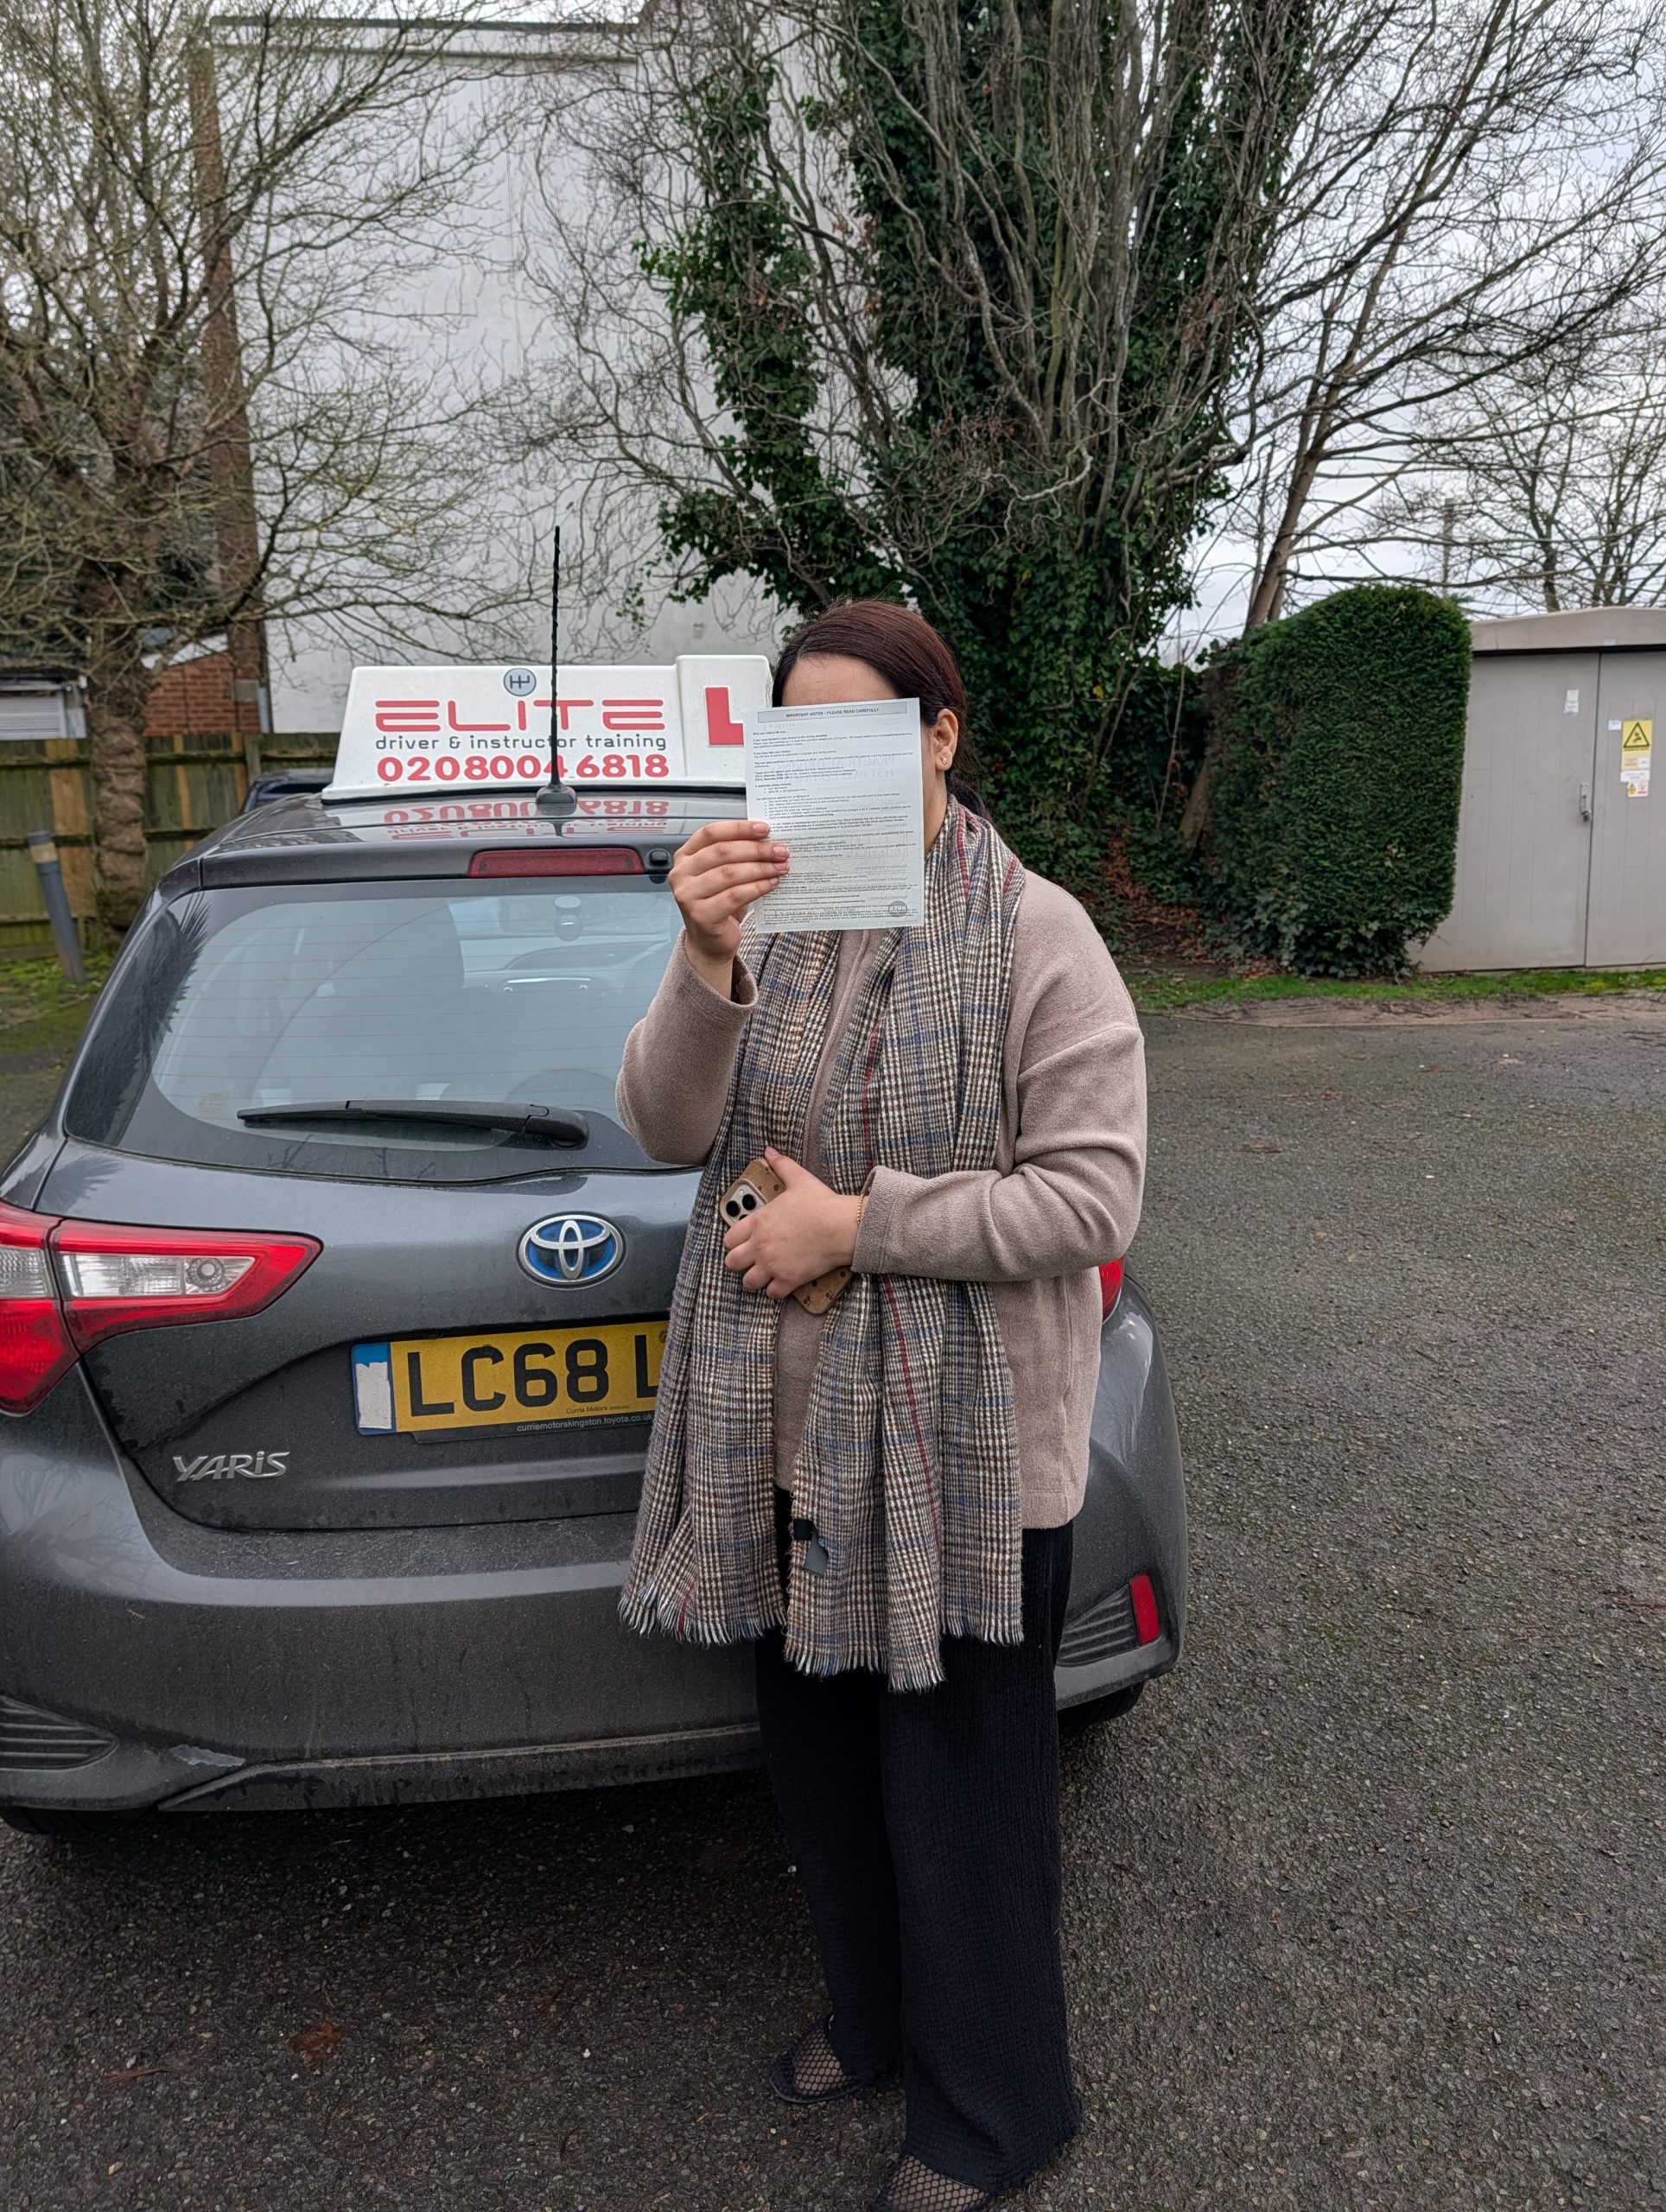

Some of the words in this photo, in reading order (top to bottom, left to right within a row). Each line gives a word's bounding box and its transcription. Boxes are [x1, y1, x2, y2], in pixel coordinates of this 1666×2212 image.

[375, 699, 664, 732] ELITE
[704, 686, 745, 746] L
[375, 735, 439, 750] driver
[448, 735, 461, 750] &
[586, 734, 667, 752] training
[407, 1338, 610, 1417] LC68
[586, 1405, 608, 1414] Motors
[516, 1414, 653, 1433] curriemotorskingston.toyota.co.uk
